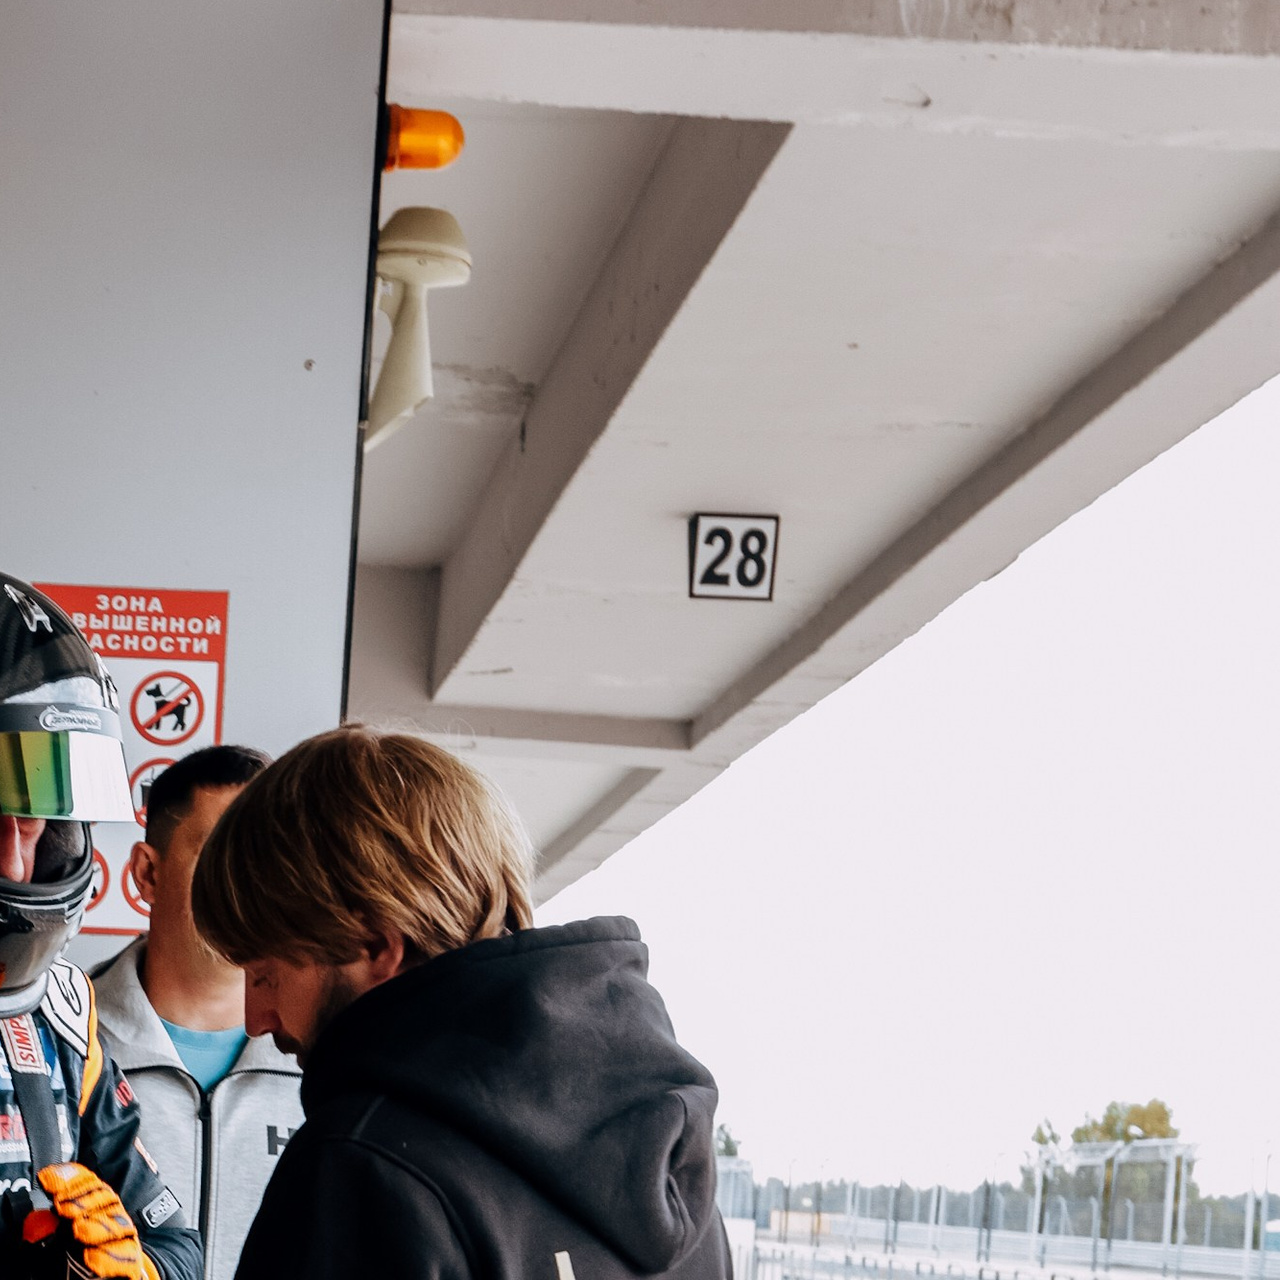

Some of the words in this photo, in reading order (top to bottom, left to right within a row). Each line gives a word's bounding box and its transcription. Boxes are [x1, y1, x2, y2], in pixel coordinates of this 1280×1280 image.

[700, 526, 768, 588] 28
[96, 594, 164, 614] ЗОНА
[83, 633, 209, 654] АСНОСТИ
